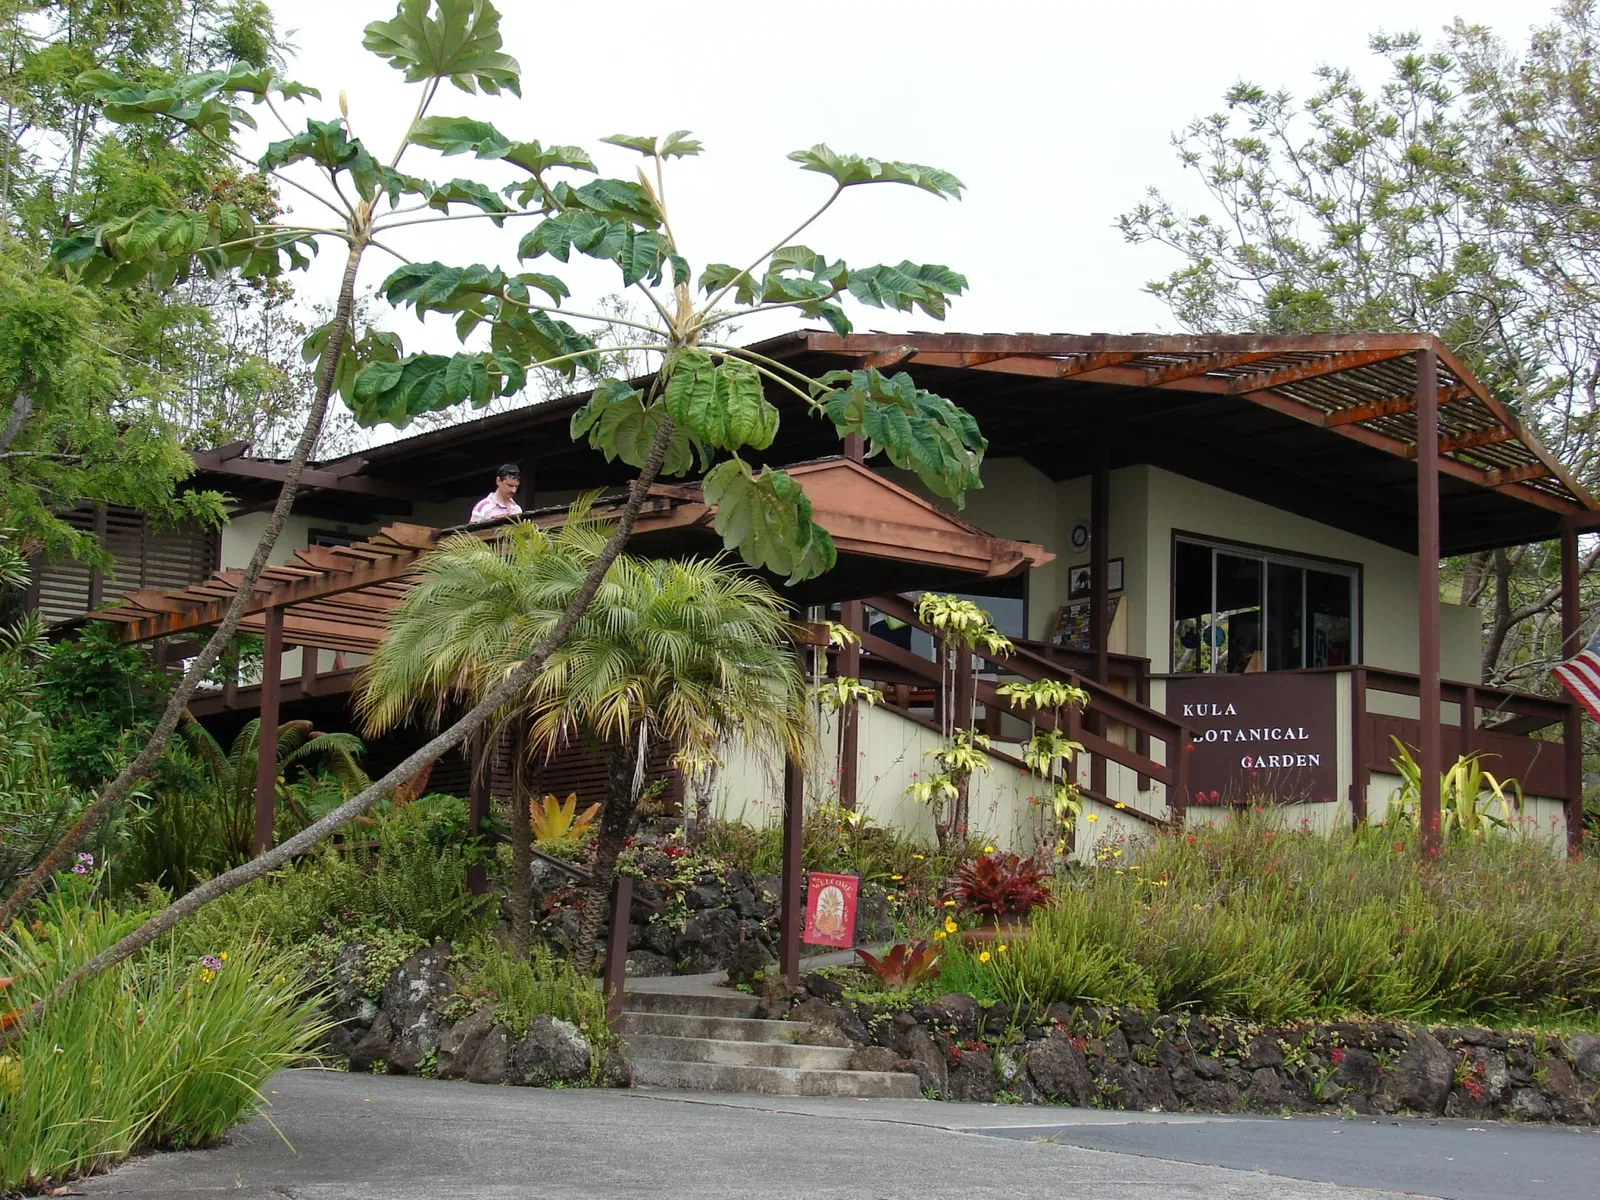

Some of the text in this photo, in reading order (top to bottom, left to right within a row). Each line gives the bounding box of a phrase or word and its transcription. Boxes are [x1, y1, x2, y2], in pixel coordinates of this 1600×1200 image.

[1183, 703, 1237, 717] KULA
[1241, 754, 1321, 769] GARDEN
[811, 878, 852, 892] WELCOME
